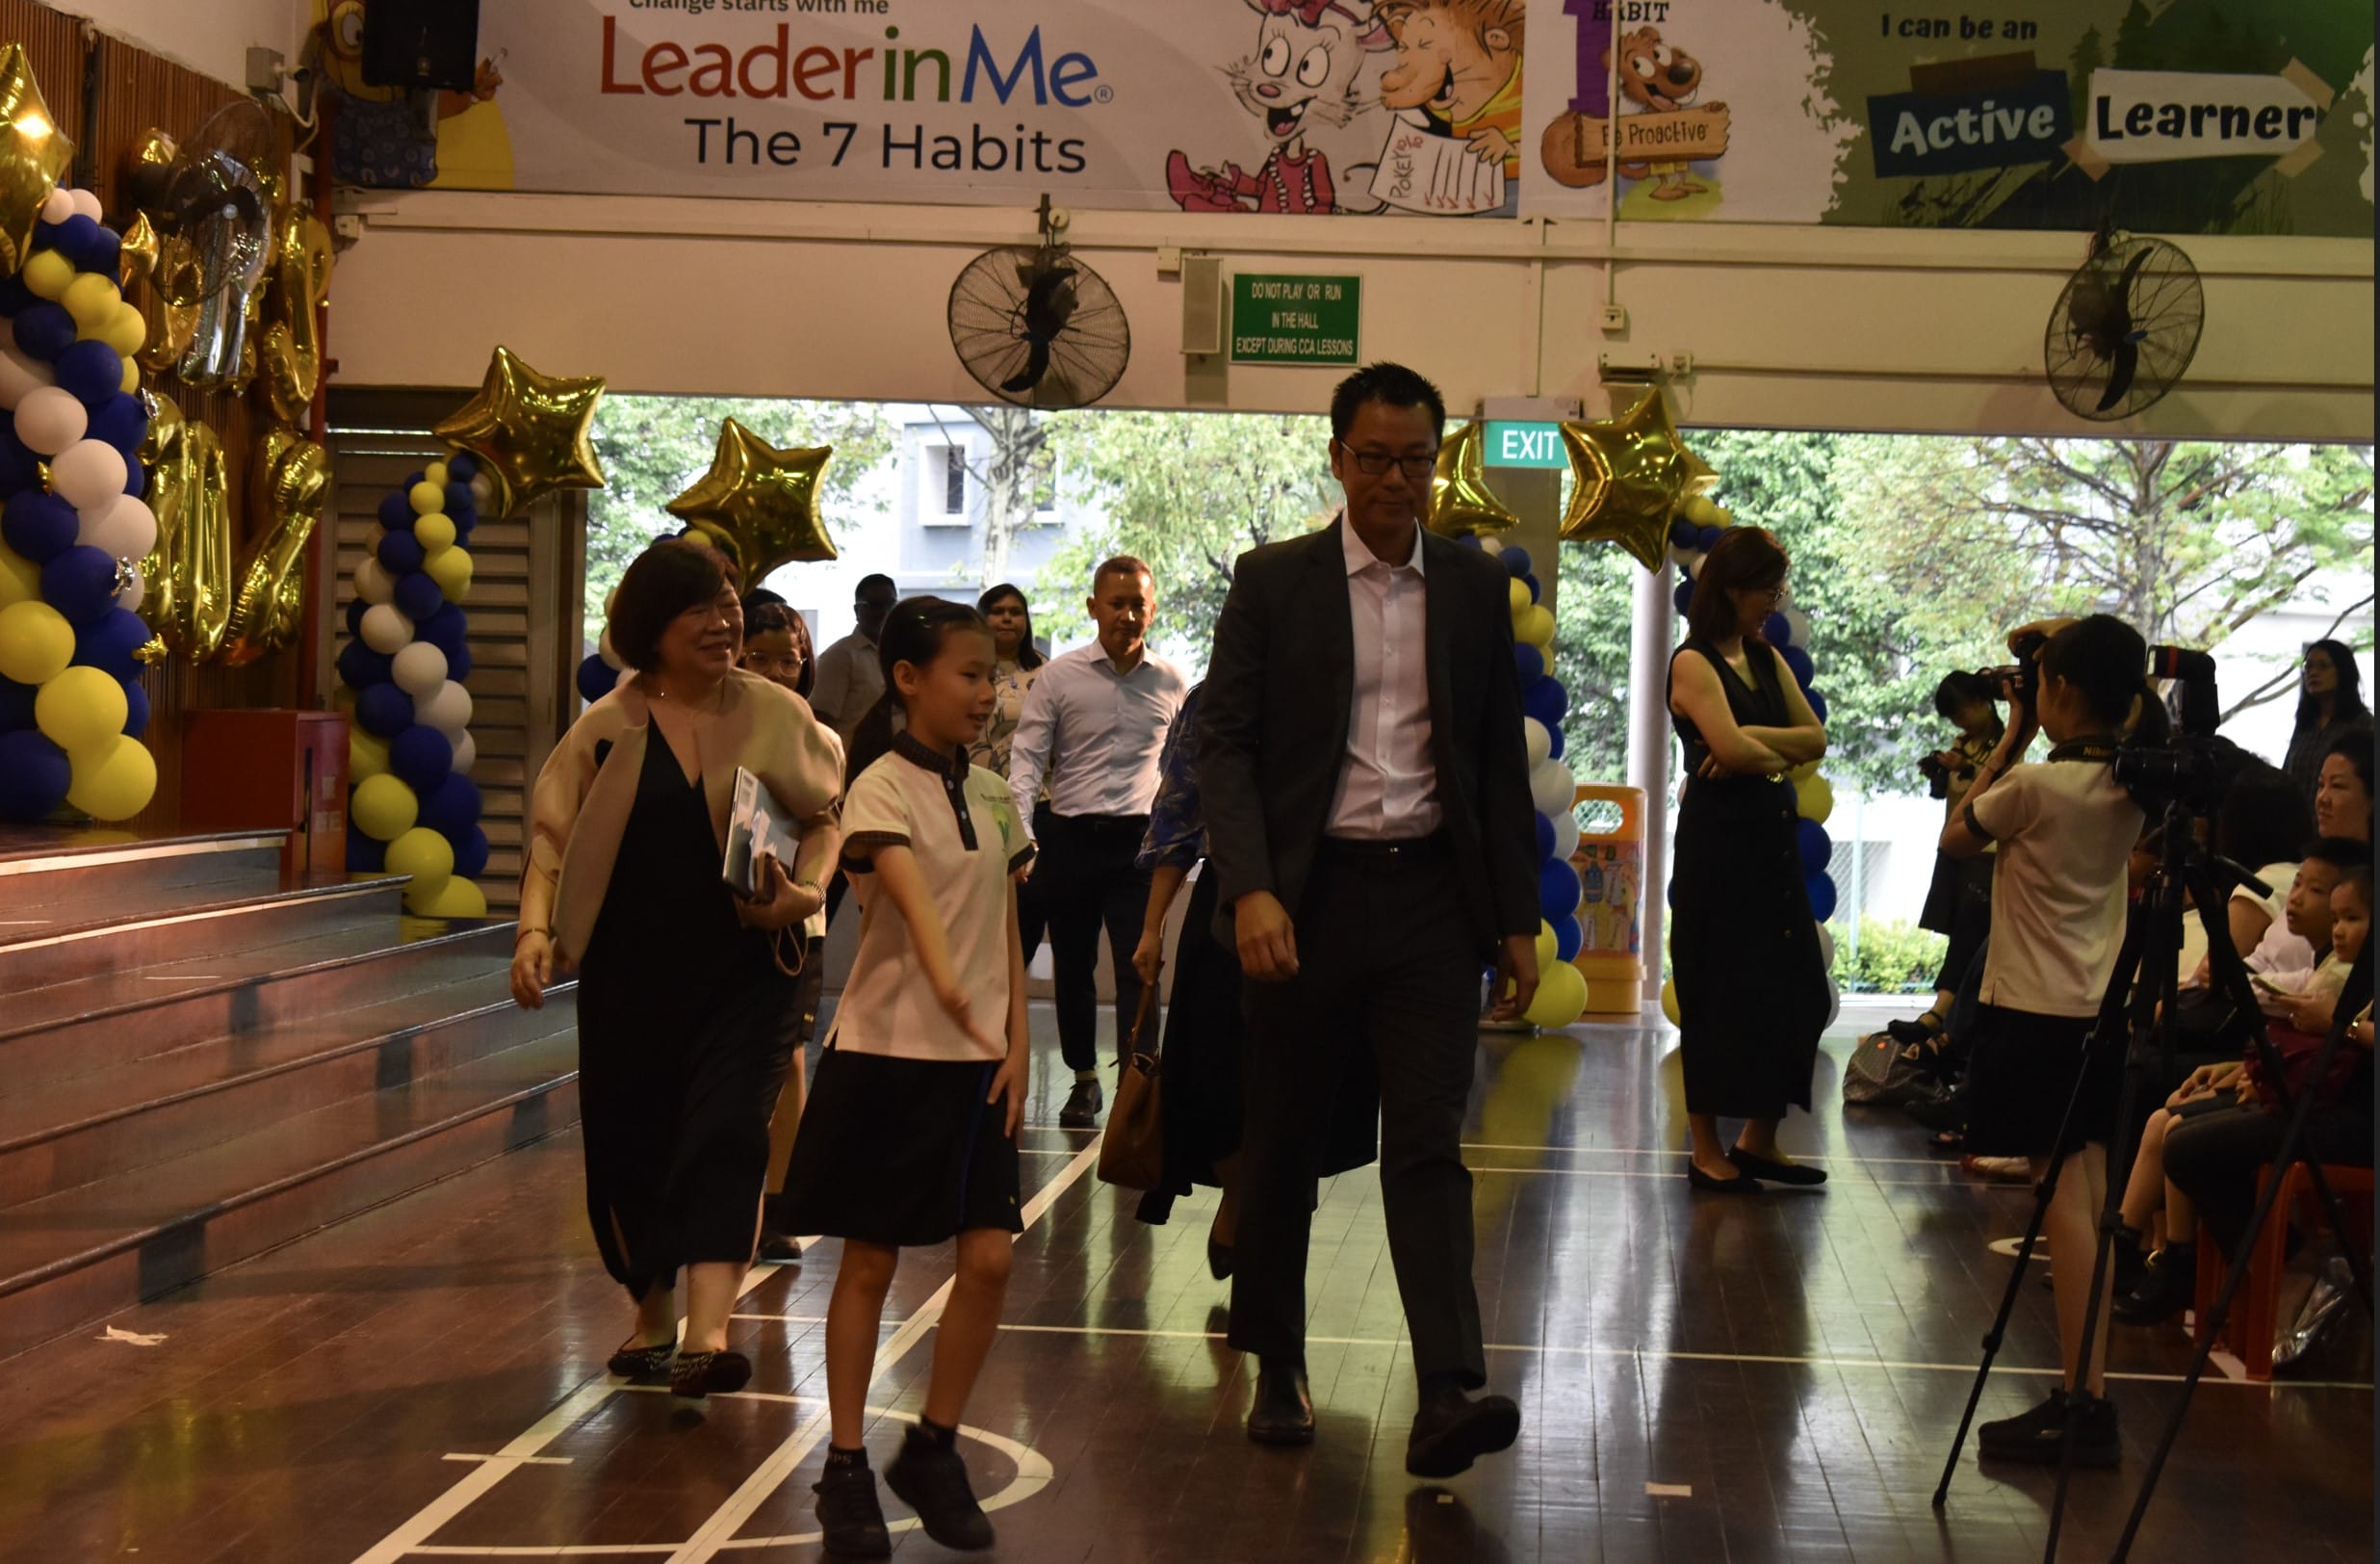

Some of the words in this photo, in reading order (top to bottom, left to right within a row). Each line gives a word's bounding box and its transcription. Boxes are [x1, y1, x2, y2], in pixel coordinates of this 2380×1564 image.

[854, 0, 889, 13] me
[1881, 13, 1890, 38] I
[1898, 17, 1951, 39] can
[1960, 15, 1994, 39] be
[2003, 19, 2037, 39] an
[1890, 99, 2057, 156] Active
[2097, 94, 2315, 142] Learner
[685, 117, 801, 166] The
[822, 121, 858, 168] 7
[883, 123, 1087, 173] Habits
[1252, 282, 1264, 299] DO
[1265, 282, 1281, 300] NOT
[1282, 283, 1304, 300] PLAY
[1306, 284, 1320, 300] OR
[1325, 284, 1341, 300] RUN
[1272, 312, 1280, 328] IN
[1281, 312, 1297, 328] THE
[1298, 312, 1319, 328] HALL
[1236, 337, 1267, 353] EXCEPT
[1268, 337, 1297, 354] DURING
[1299, 338, 1315, 355] CCA
[1316, 339, 1353, 355] LESSONS
[1502, 430, 1560, 460] EXIT
